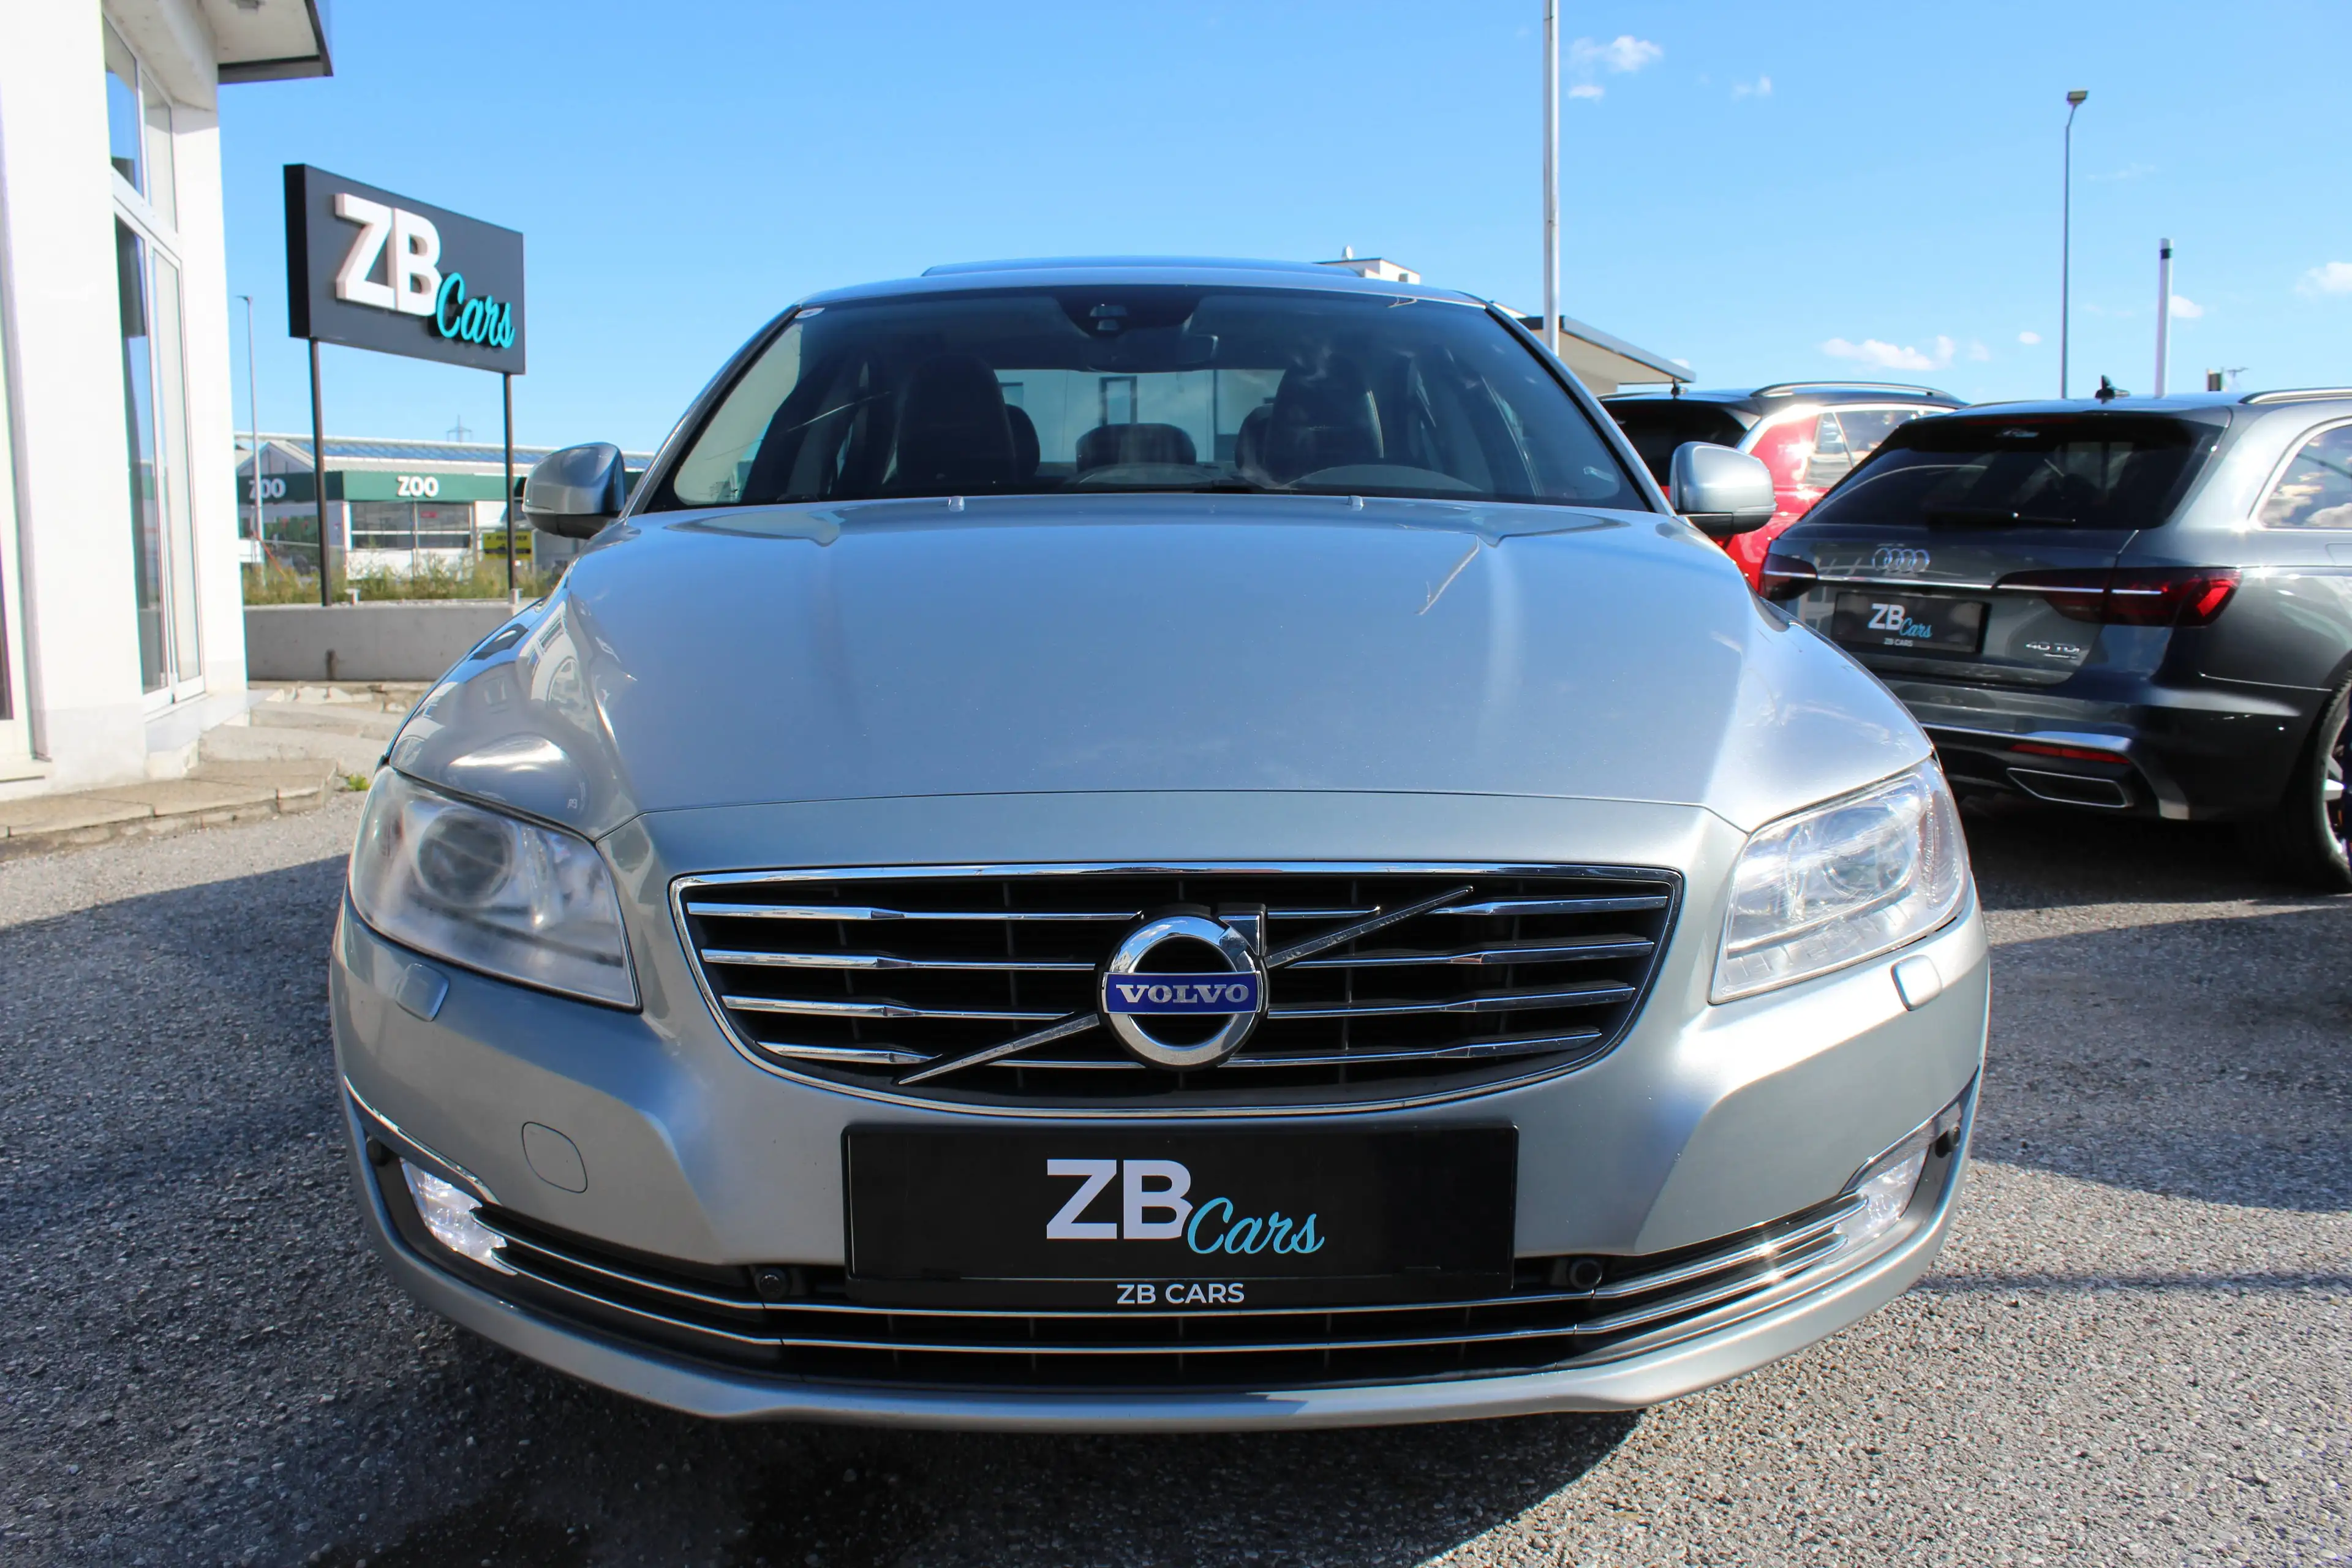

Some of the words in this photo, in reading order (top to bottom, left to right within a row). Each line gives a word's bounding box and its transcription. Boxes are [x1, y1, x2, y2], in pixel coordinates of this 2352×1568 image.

[335, 193, 442, 316] ZB
[435, 272, 514, 349] Cars
[397, 475, 439, 497] ZOO
[1868, 603, 1905, 630] ZB
[1899, 617, 1932, 638] Cars
[1116, 984, 1249, 1003] VOLVO
[1046, 1159, 1193, 1240] ZB
[1187, 1197, 1325, 1254] Cars
[1117, 1283, 1156, 1304] ZB
[1165, 1283, 1245, 1305] CARS
